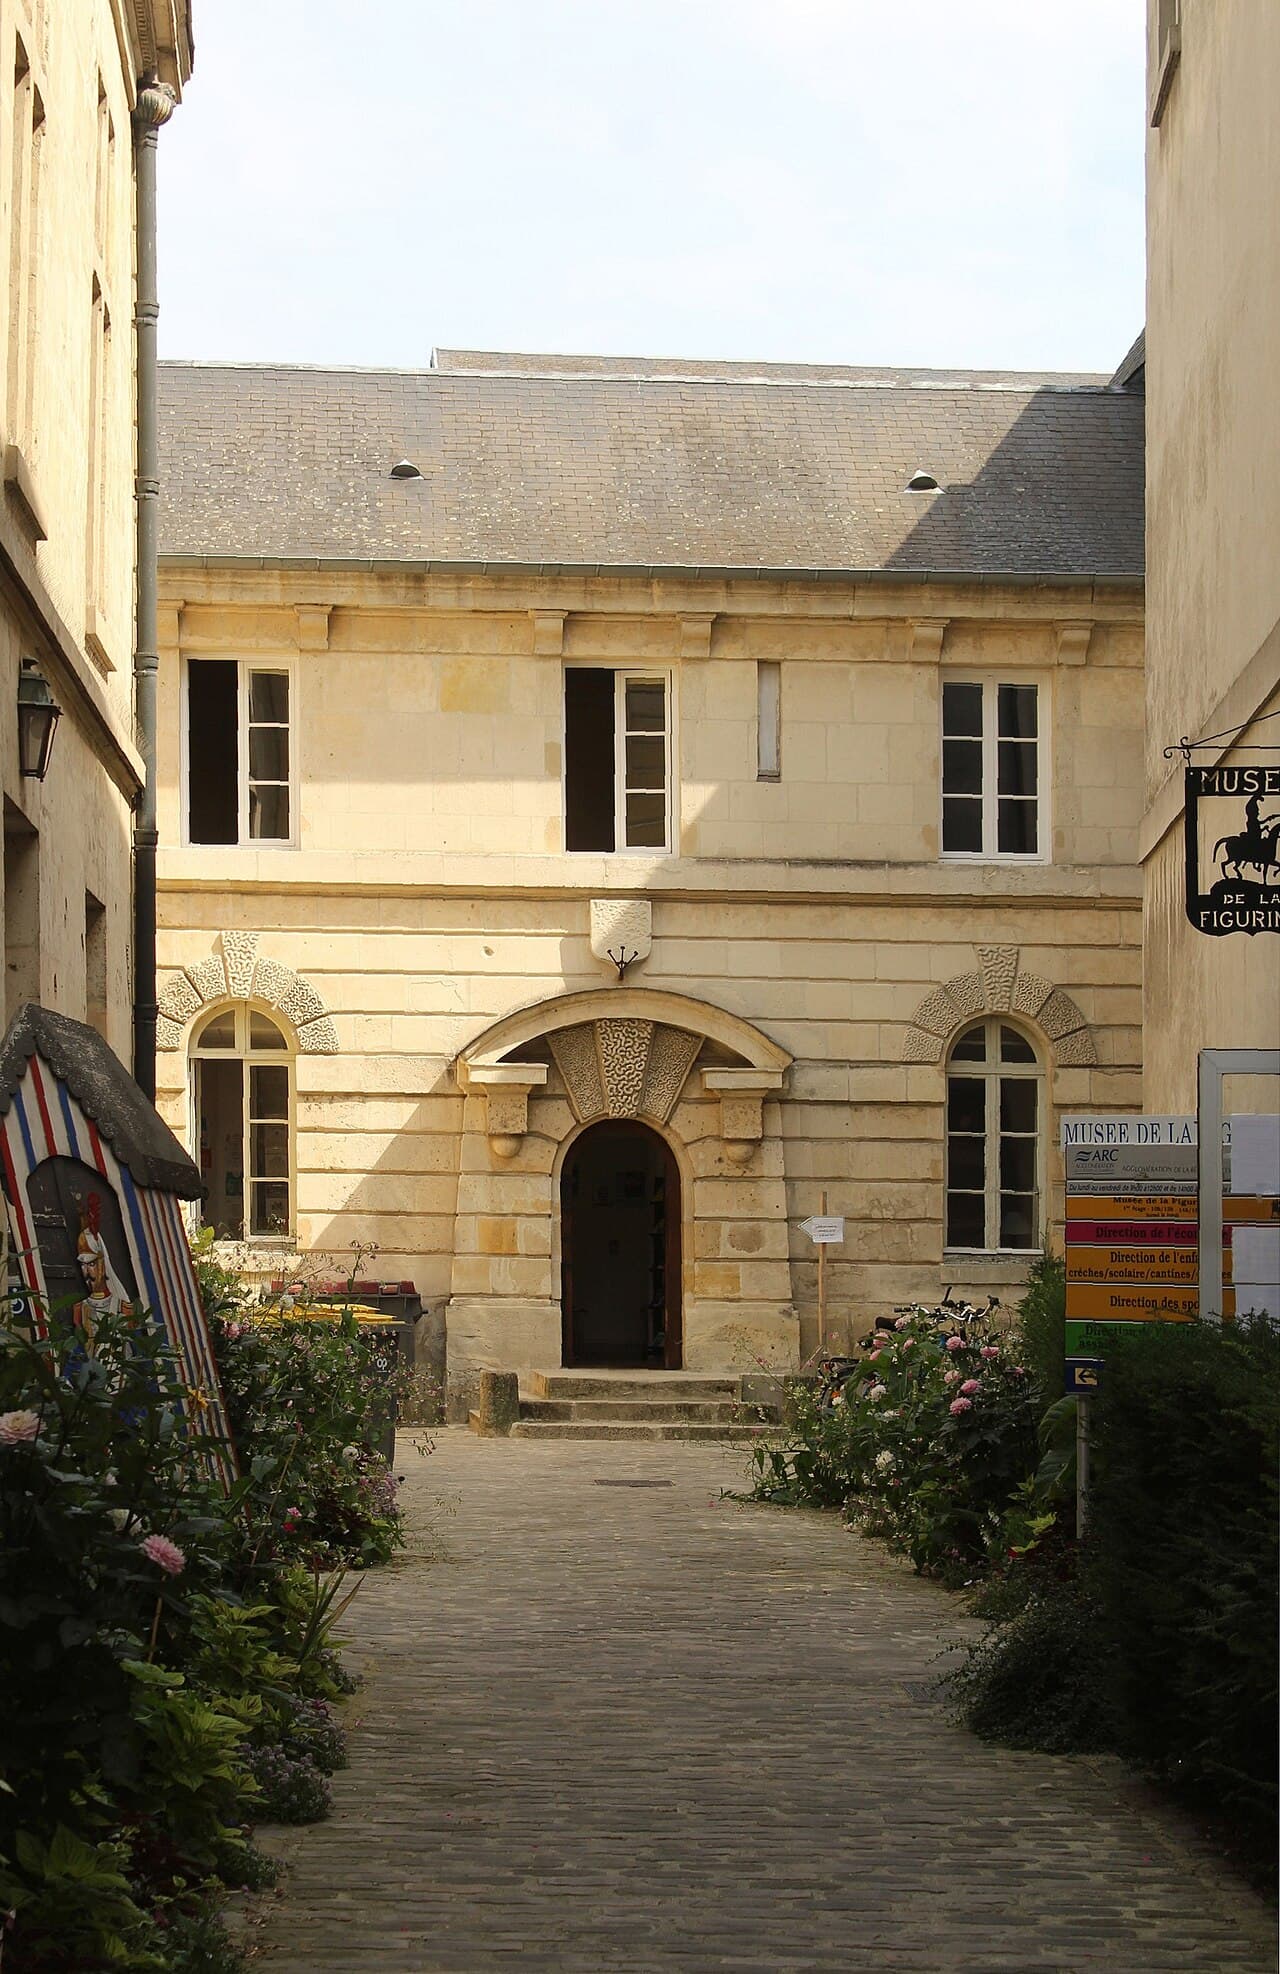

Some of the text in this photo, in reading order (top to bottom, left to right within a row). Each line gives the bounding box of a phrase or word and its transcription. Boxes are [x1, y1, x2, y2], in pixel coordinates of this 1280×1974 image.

[1201, 770, 1280, 793] MUSE
[1223, 893, 1280, 905] DE LA
[1200, 910, 1280, 928] FIGURIN
[1064, 1122, 1192, 1144] MUSEE DE LA
[1092, 1149, 1119, 1162] ARC
[1171, 1198, 1198, 1207] Figur
[1096, 1226, 1146, 1238] Direction
[1151, 1228, 1164, 1239] de
[1110, 1251, 1198, 1264] Direction de l'enf
[1110, 1295, 1199, 1314] Direction des spo
